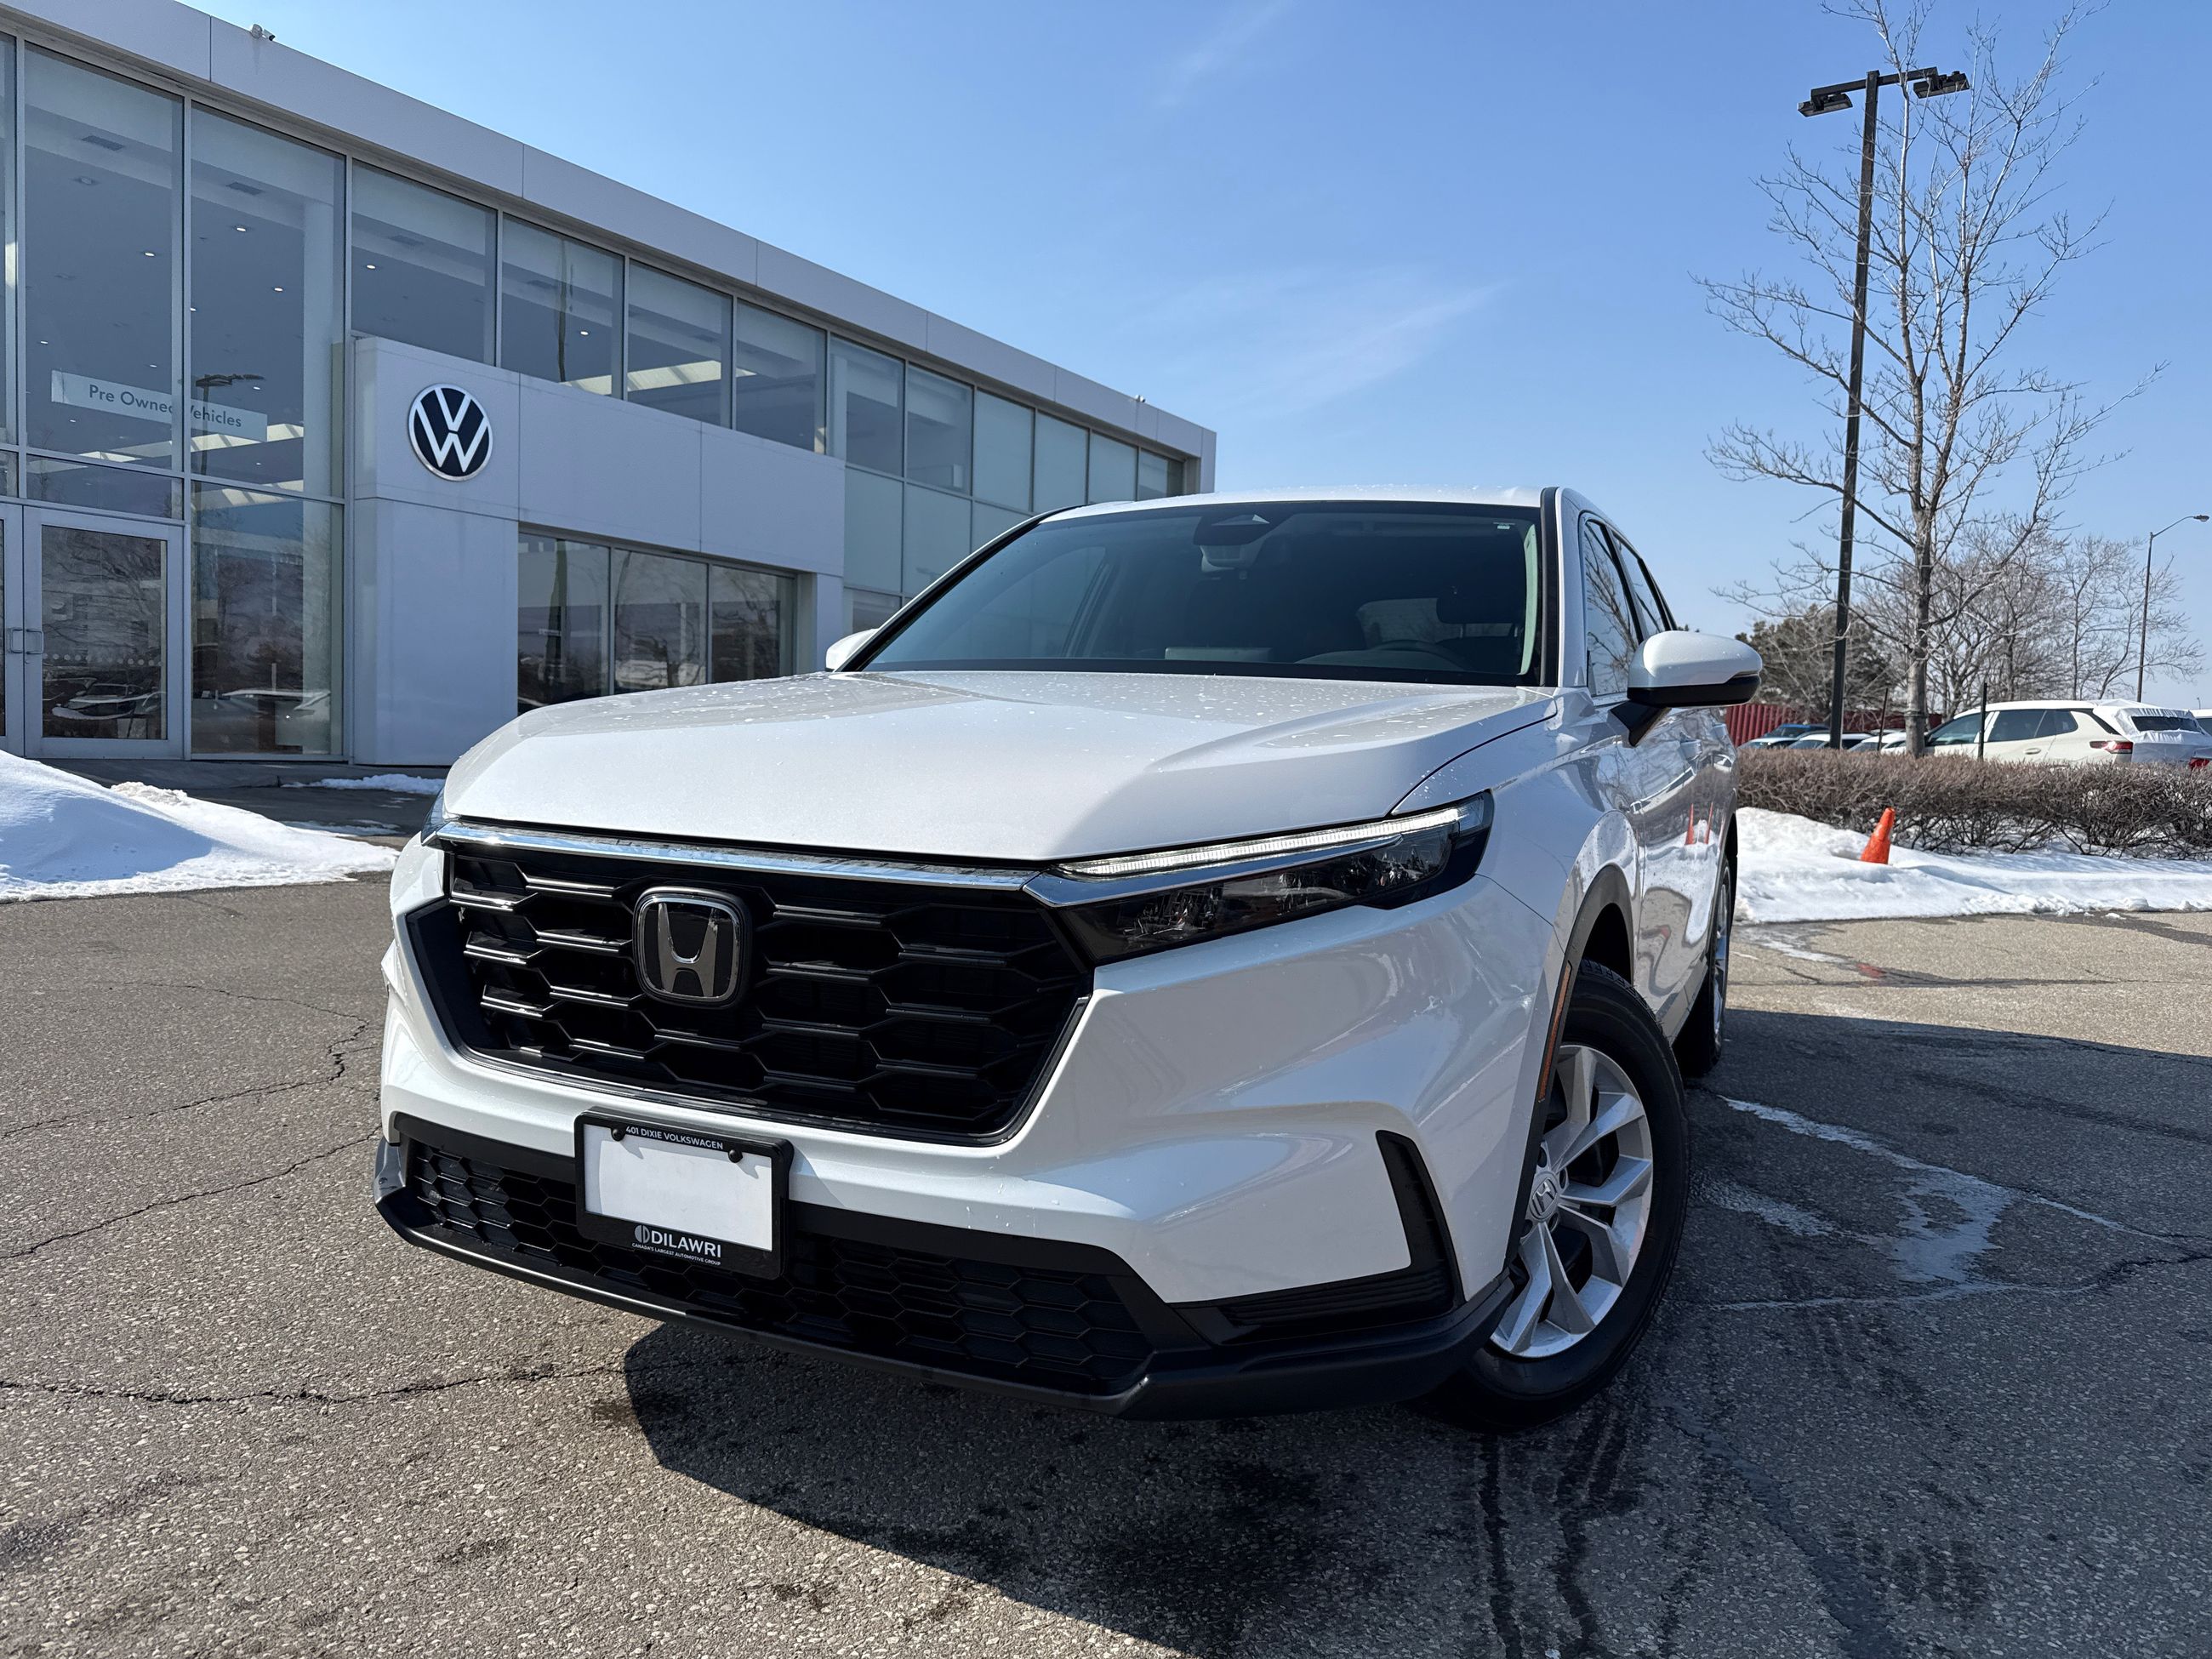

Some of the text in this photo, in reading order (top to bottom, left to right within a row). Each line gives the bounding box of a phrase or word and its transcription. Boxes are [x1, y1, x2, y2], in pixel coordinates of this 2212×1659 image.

[89, 385, 115, 402] Pre
[411, 385, 491, 476] VW
[626, 1126, 723, 1149] 401 DIXIE VOLKSWAGEN
[632, 1242, 654, 1251] CANADA'S
[654, 1247, 675, 1256] LARGEST
[675, 1252, 704, 1263] AUTOMOTIVE
[651, 1230, 721, 1258] DILAWRI
